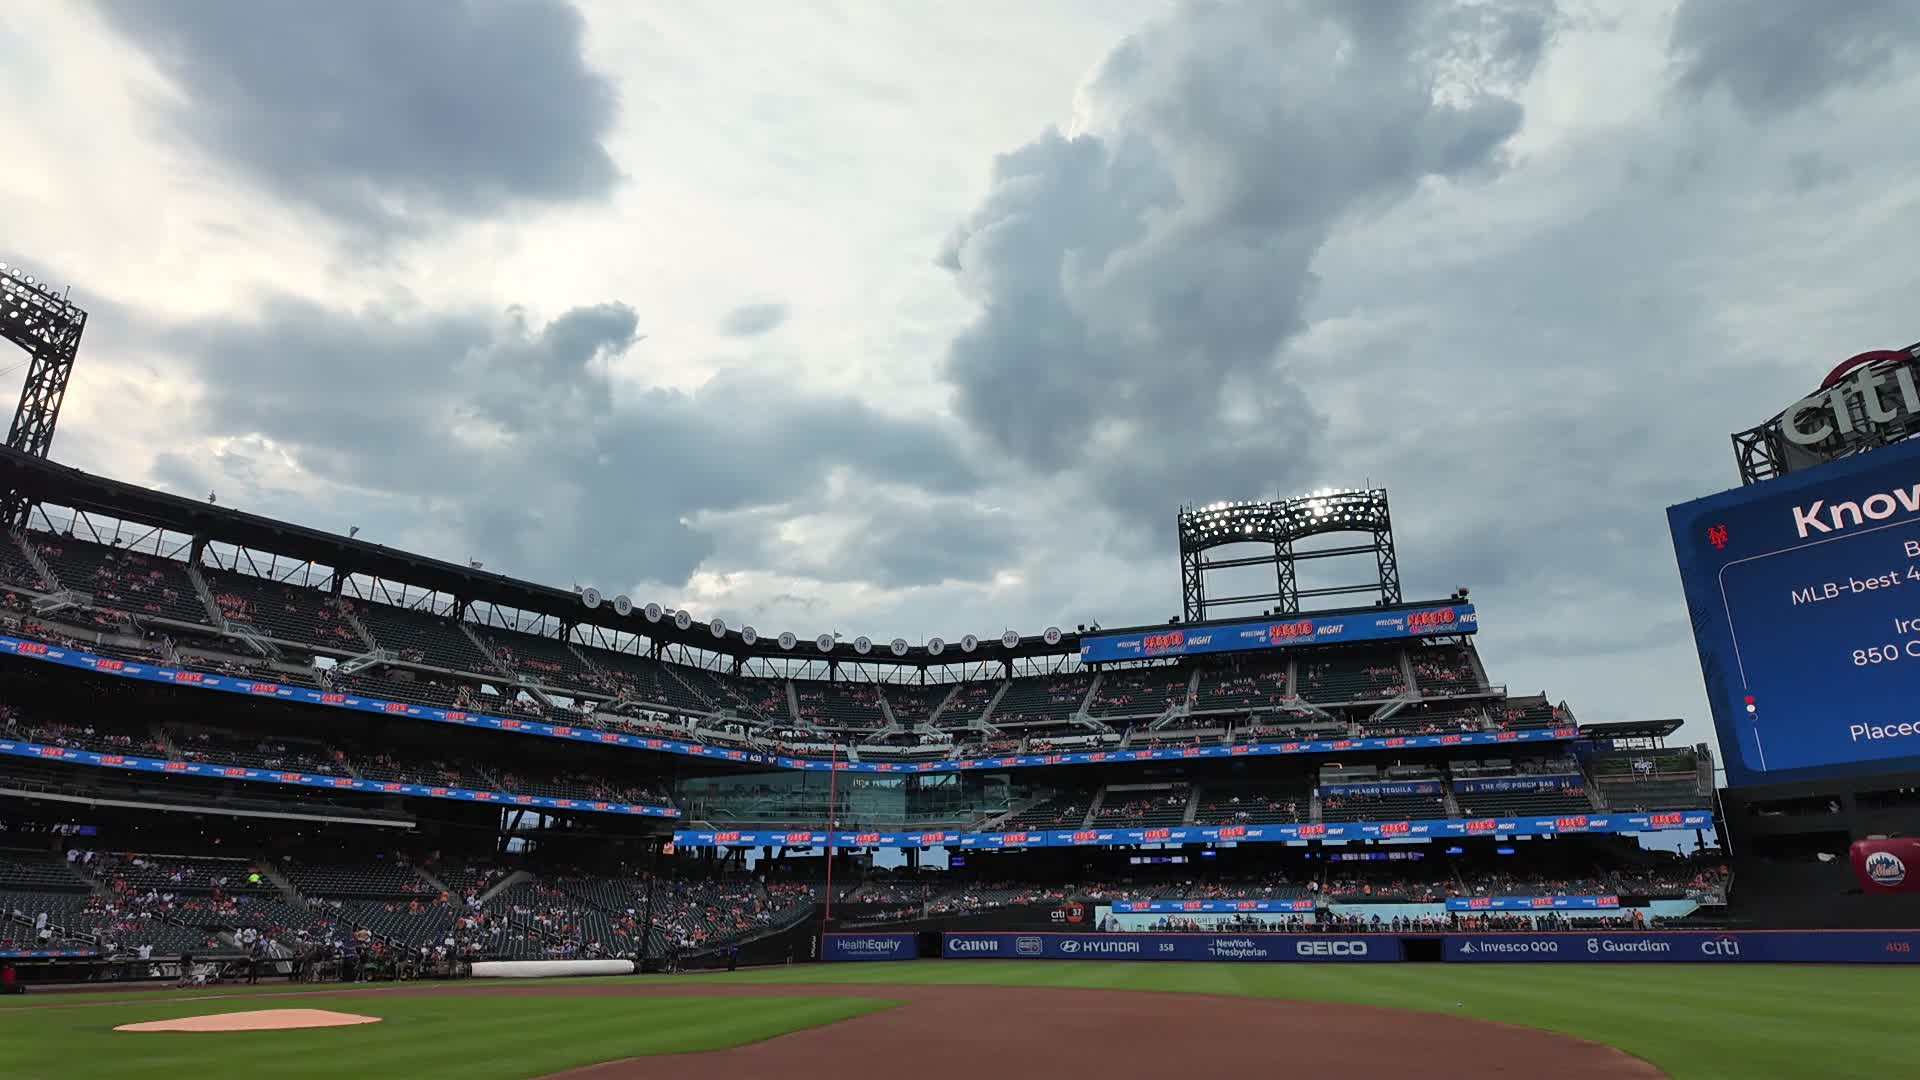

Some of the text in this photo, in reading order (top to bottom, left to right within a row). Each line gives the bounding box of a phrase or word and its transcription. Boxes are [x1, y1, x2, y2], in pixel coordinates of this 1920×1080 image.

[1782, 366, 1920, 444] citi
[1791, 571, 1901, 605] MLB-best
[588, 594, 595, 603] 5
[678, 615, 688, 625] 24
[1407, 608, 1454, 627] NARUTO
[714, 623, 722, 633] 17
[1317, 624, 1344, 635] NIGHT
[783, 636, 791, 645] 31
[1046, 631, 1057, 640] 42
[821, 639, 830, 648] 41
[859, 640, 867, 649] 14
[1187, 636, 1212, 646] NIGHT
[895, 643, 904, 651] 37
[1853, 644, 1899, 666] 850
[1382, 786, 1412, 794] TEQUILA
[1051, 909, 1065, 918] citi
[837, 939, 901, 952] HealthEquity
[949, 938, 998, 951] Canon
[1083, 942, 1139, 952] HYUNDAI
[1159, 943, 1174, 952] 358
[1296, 941, 1367, 955] GEICO
[1481, 941, 1558, 952] Invesco QQQ
[1602, 940, 1670, 952] Guardian
[1701, 938, 1740, 955] citi
[1217, 948, 1267, 958] Presbyterian
